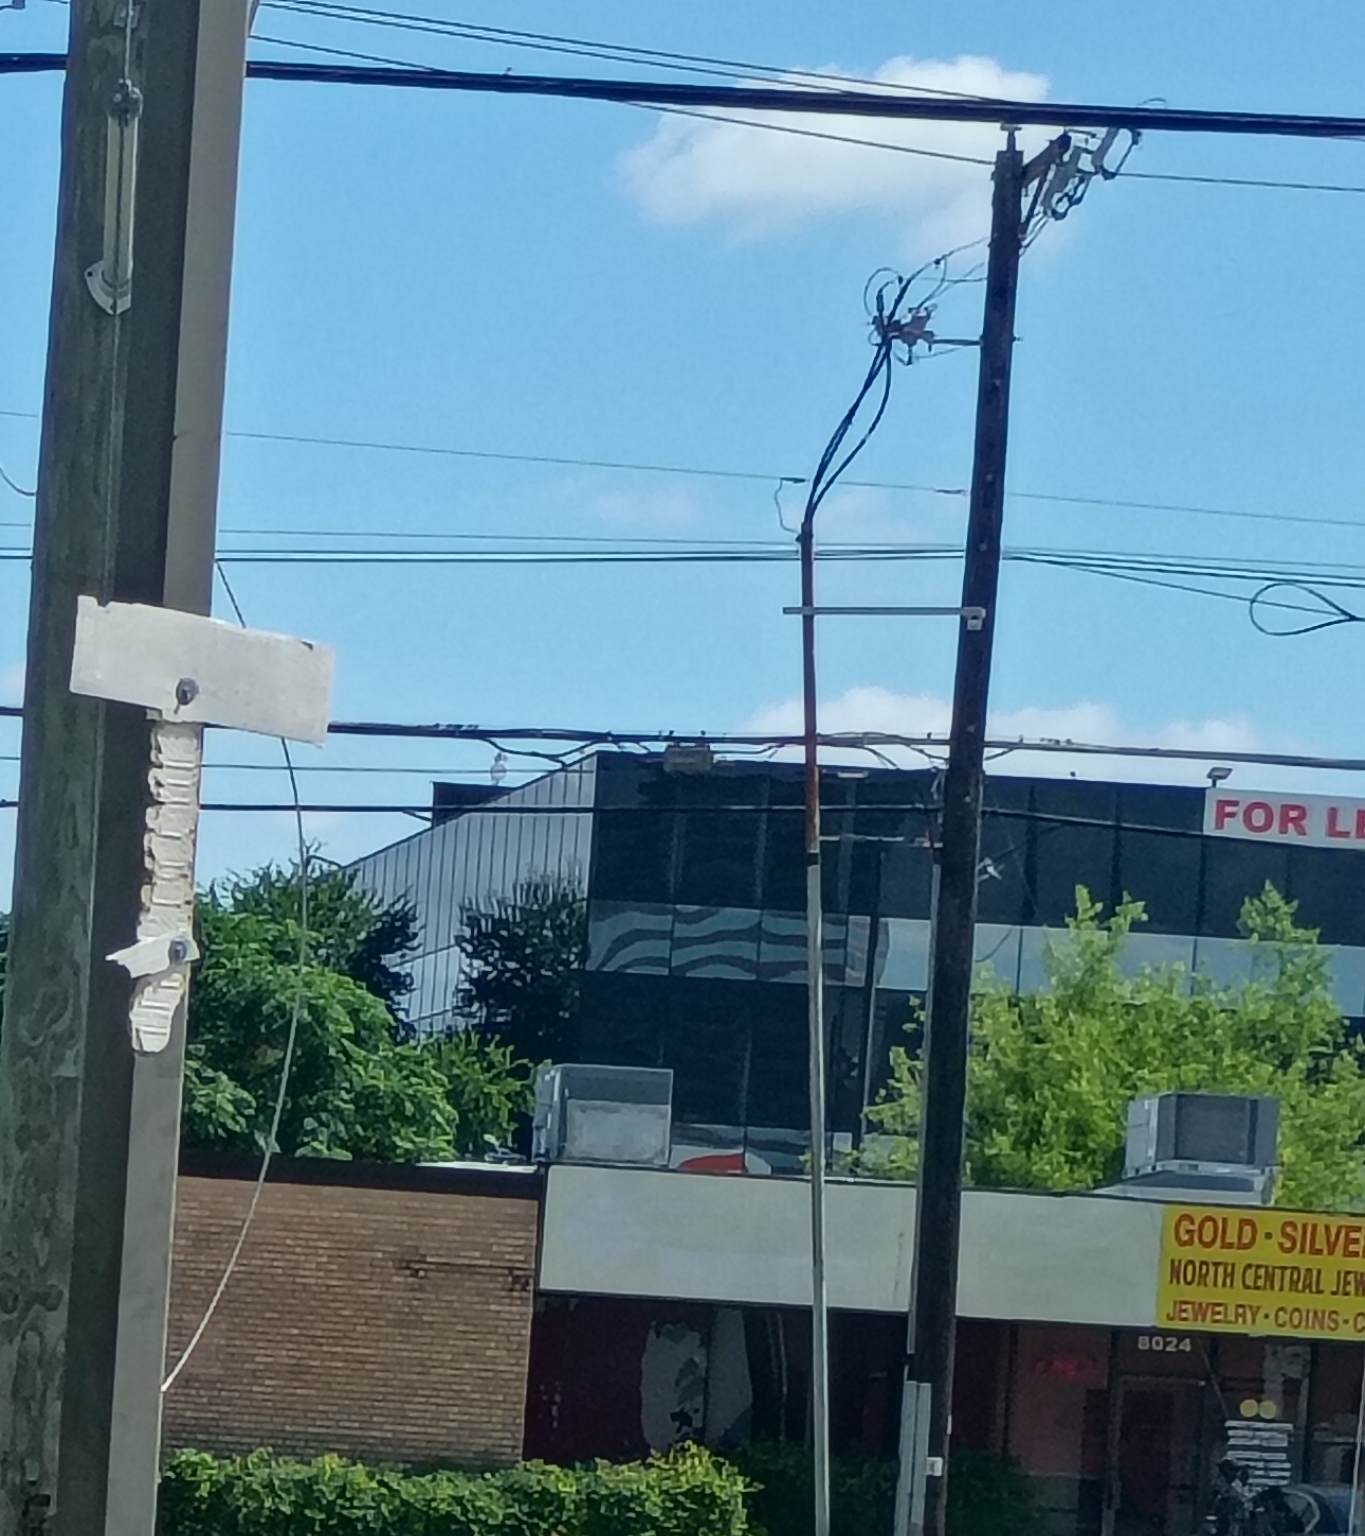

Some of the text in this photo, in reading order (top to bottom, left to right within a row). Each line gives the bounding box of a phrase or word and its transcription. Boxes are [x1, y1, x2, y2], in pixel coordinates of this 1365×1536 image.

[1214, 799, 1307, 836] FOR
[1173, 1213, 1365, 1258] GOLD SILVE
[1169, 1258, 1236, 1289] NORTH
[1241, 1263, 1325, 1294] CENTRAL
[1166, 1300, 1262, 1325] JEWELRY
[1274, 1306, 1340, 1331] COINS
